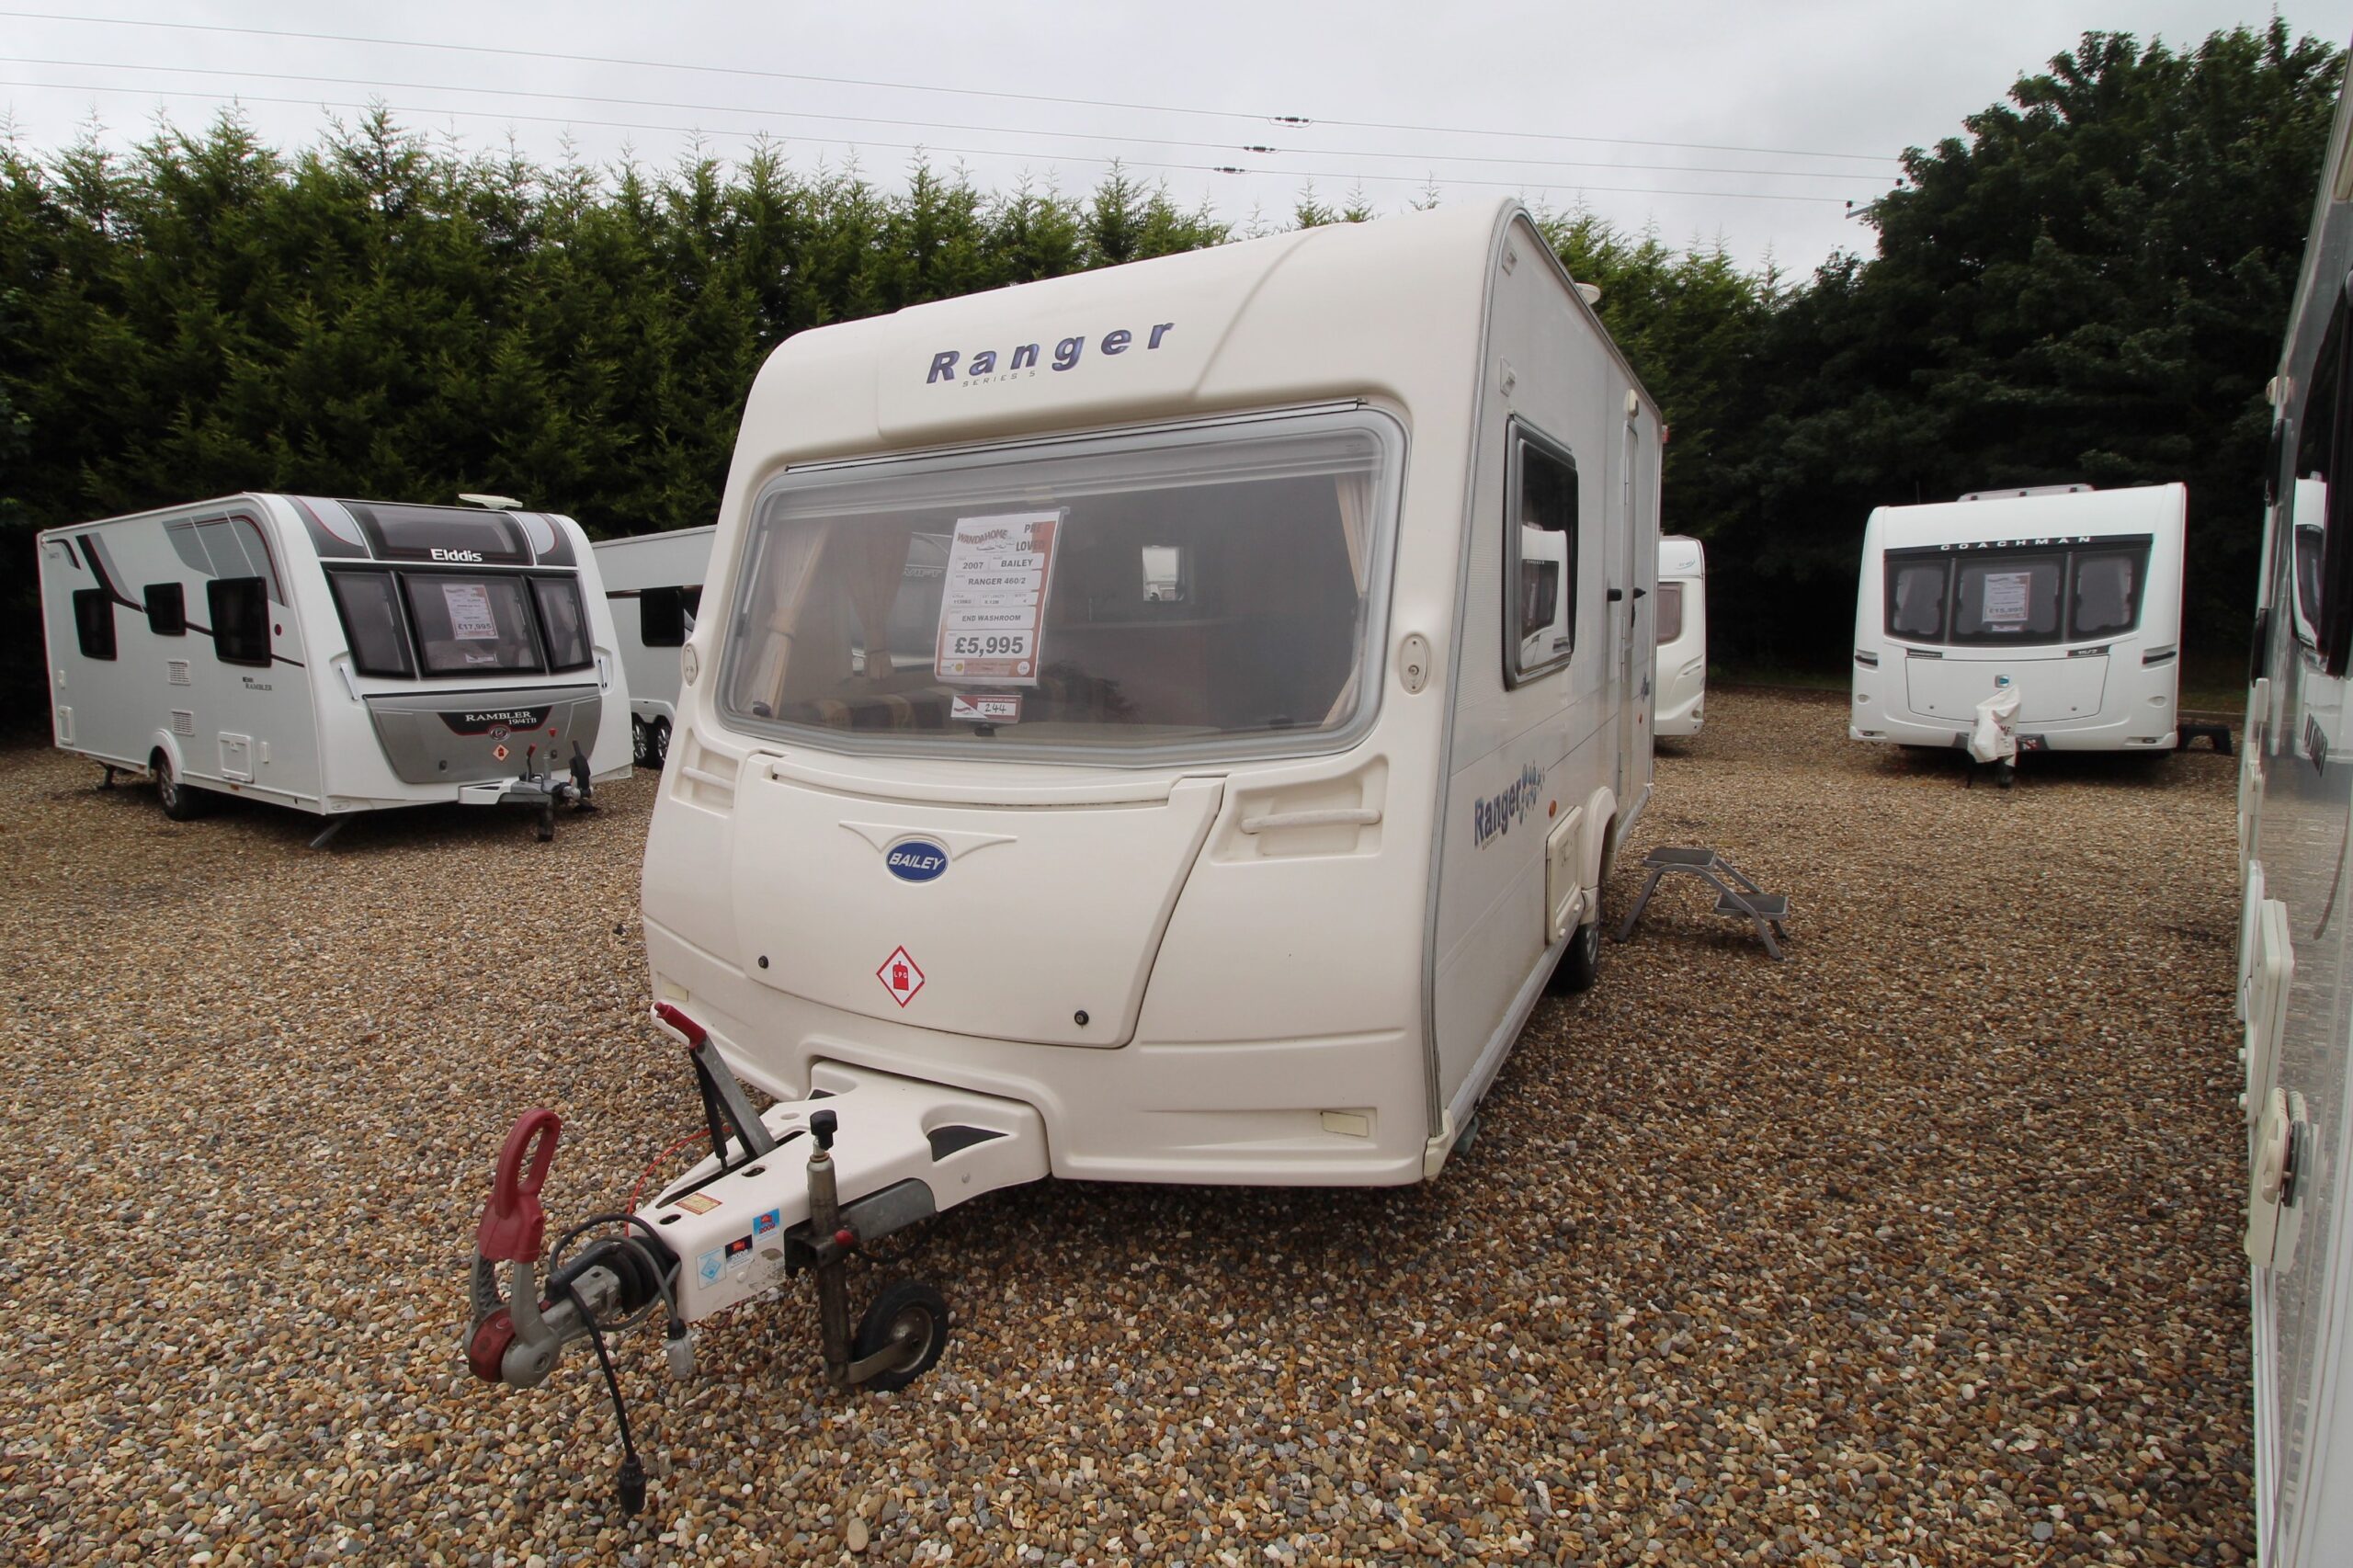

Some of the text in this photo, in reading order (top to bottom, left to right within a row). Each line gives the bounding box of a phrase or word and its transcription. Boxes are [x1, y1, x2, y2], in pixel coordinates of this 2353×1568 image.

[926, 322, 1175, 384] Ranger
[962, 372, 1017, 388] SERIES
[1024, 523, 1042, 533] PRE
[957, 528, 1008, 545] WANDAHOME
[1016, 540, 1044, 551] LOVED
[1940, 536, 2091, 551] COACHMAN
[430, 548, 483, 562] Elddis
[962, 559, 1034, 570] 2007 BAILEY
[968, 577, 1002, 585] RANGER
[978, 614, 1021, 622] WASHROOM
[954, 636, 1024, 657] £5,995
[984, 703, 1006, 714] 244
[465, 710, 531, 722] RAMBLER
[508, 717, 537, 725] 19/4TB
[1474, 778, 1522, 846] Ranger
[888, 852, 945, 871] BAILEY
